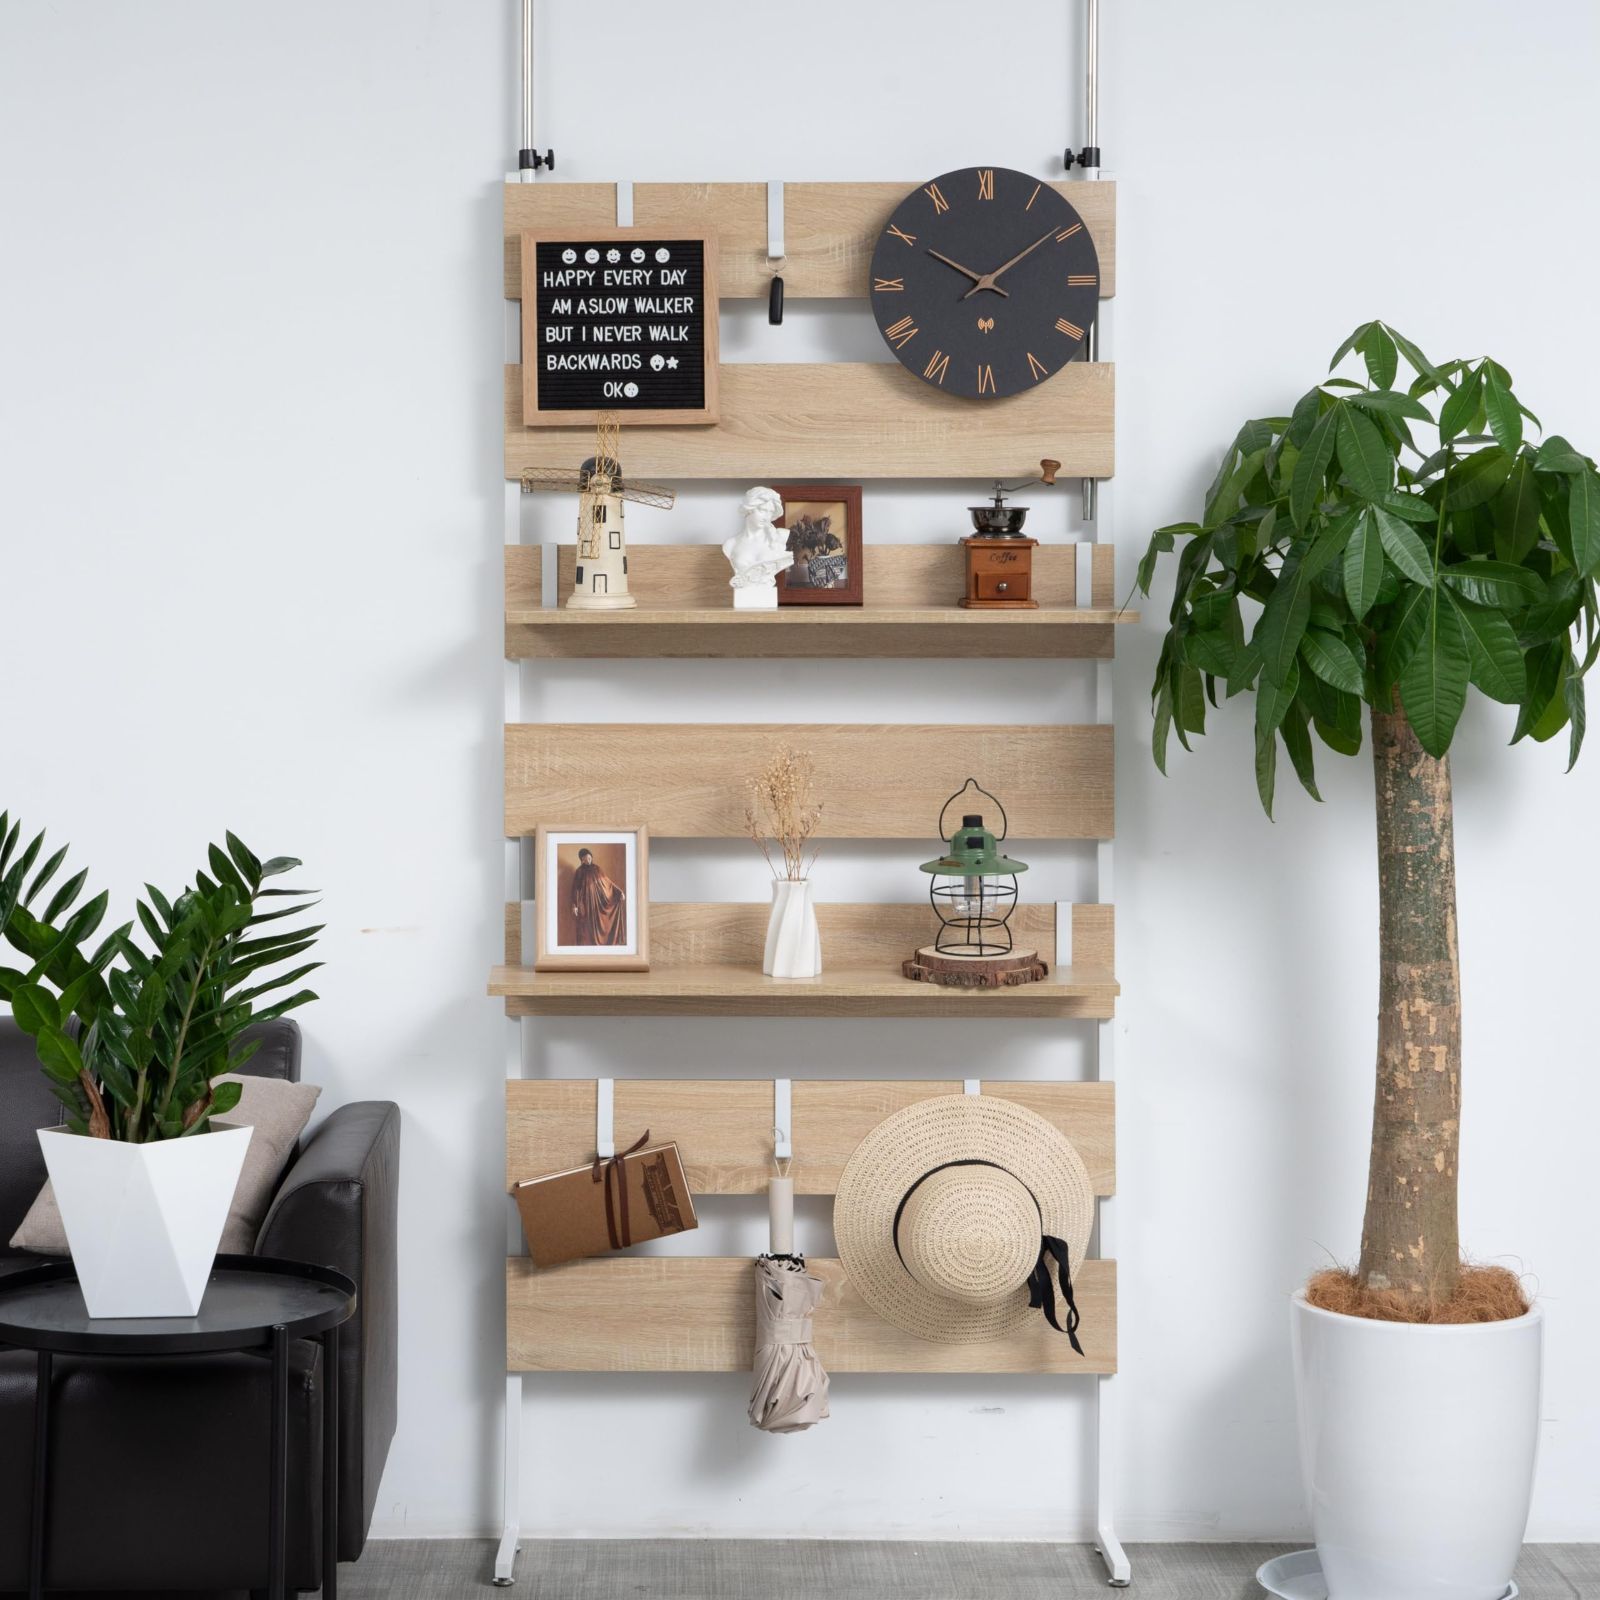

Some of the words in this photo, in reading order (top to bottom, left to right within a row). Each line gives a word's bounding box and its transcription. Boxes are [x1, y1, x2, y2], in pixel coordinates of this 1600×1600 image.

[978, 170, 994, 200] XII
[924, 183, 949, 214] XI
[886, 224, 917, 246] X
[543, 269, 596, 288] HAPPY
[603, 269, 653, 286] EVERY
[660, 269, 688, 286] DAY
[874, 278, 904, 291] IX
[551, 298, 572, 315] AM
[633, 296, 694, 314] WALKER
[545, 326, 574, 343] BUT
[581, 326, 586, 342] I
[593, 325, 642, 342] NEVER
[648, 325, 689, 342] WALK
[885, 315, 919, 350] VIII
[546, 353, 642, 371] BACKWARDS
[924, 350, 949, 384] VII
[1027, 352, 1048, 380] V
[978, 364, 996, 394] VI
[603, 381, 623, 398] OK
[990, 552, 1017, 564] Coffee
